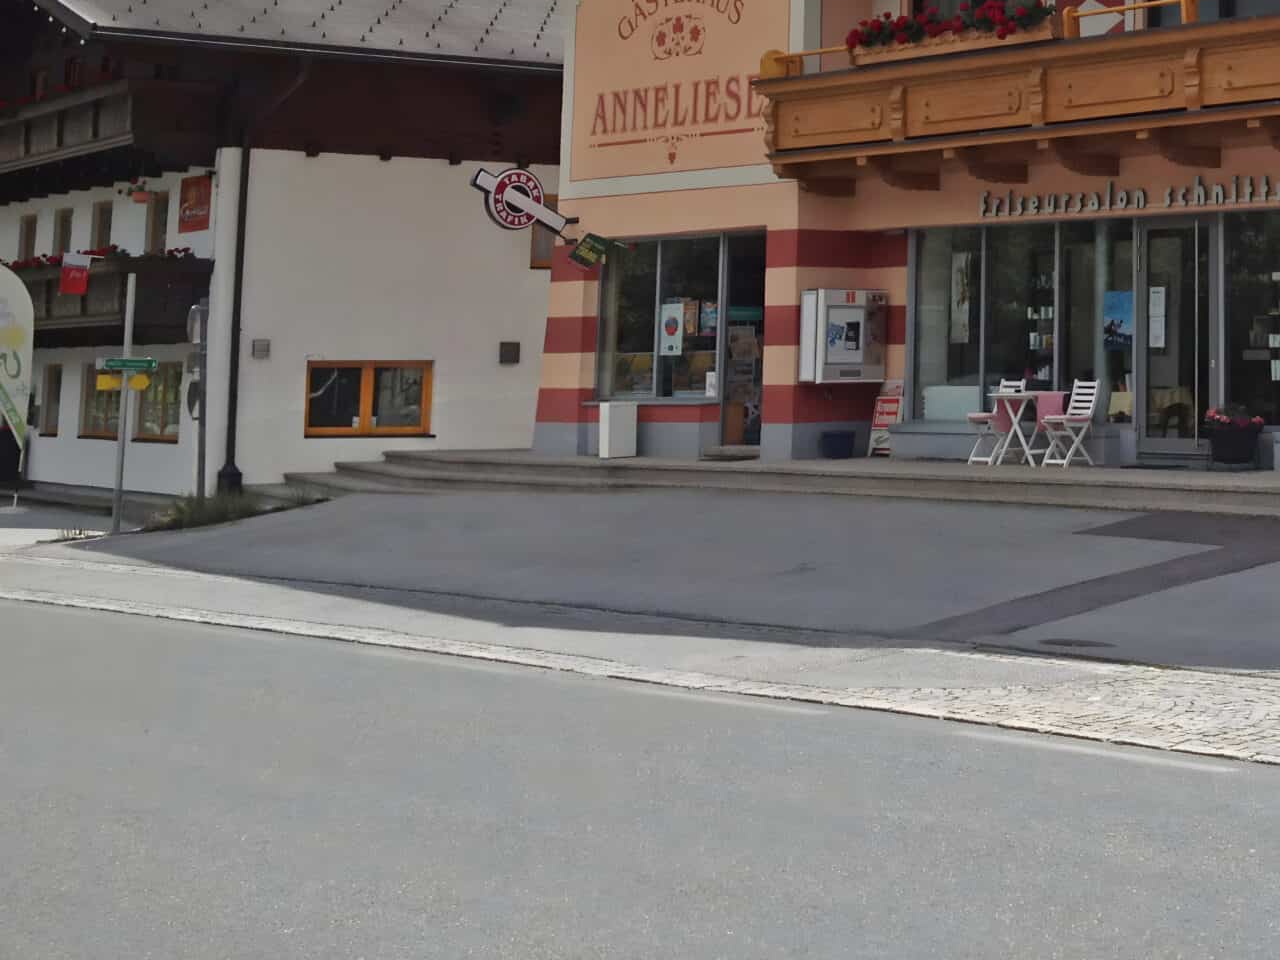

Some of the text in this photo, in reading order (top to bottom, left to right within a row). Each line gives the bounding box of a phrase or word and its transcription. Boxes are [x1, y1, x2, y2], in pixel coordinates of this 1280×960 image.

[589, 71, 764, 136] ANNELIESE
[503, 174, 540, 199] TABAK
[495, 193, 530, 225] TRAFIK
